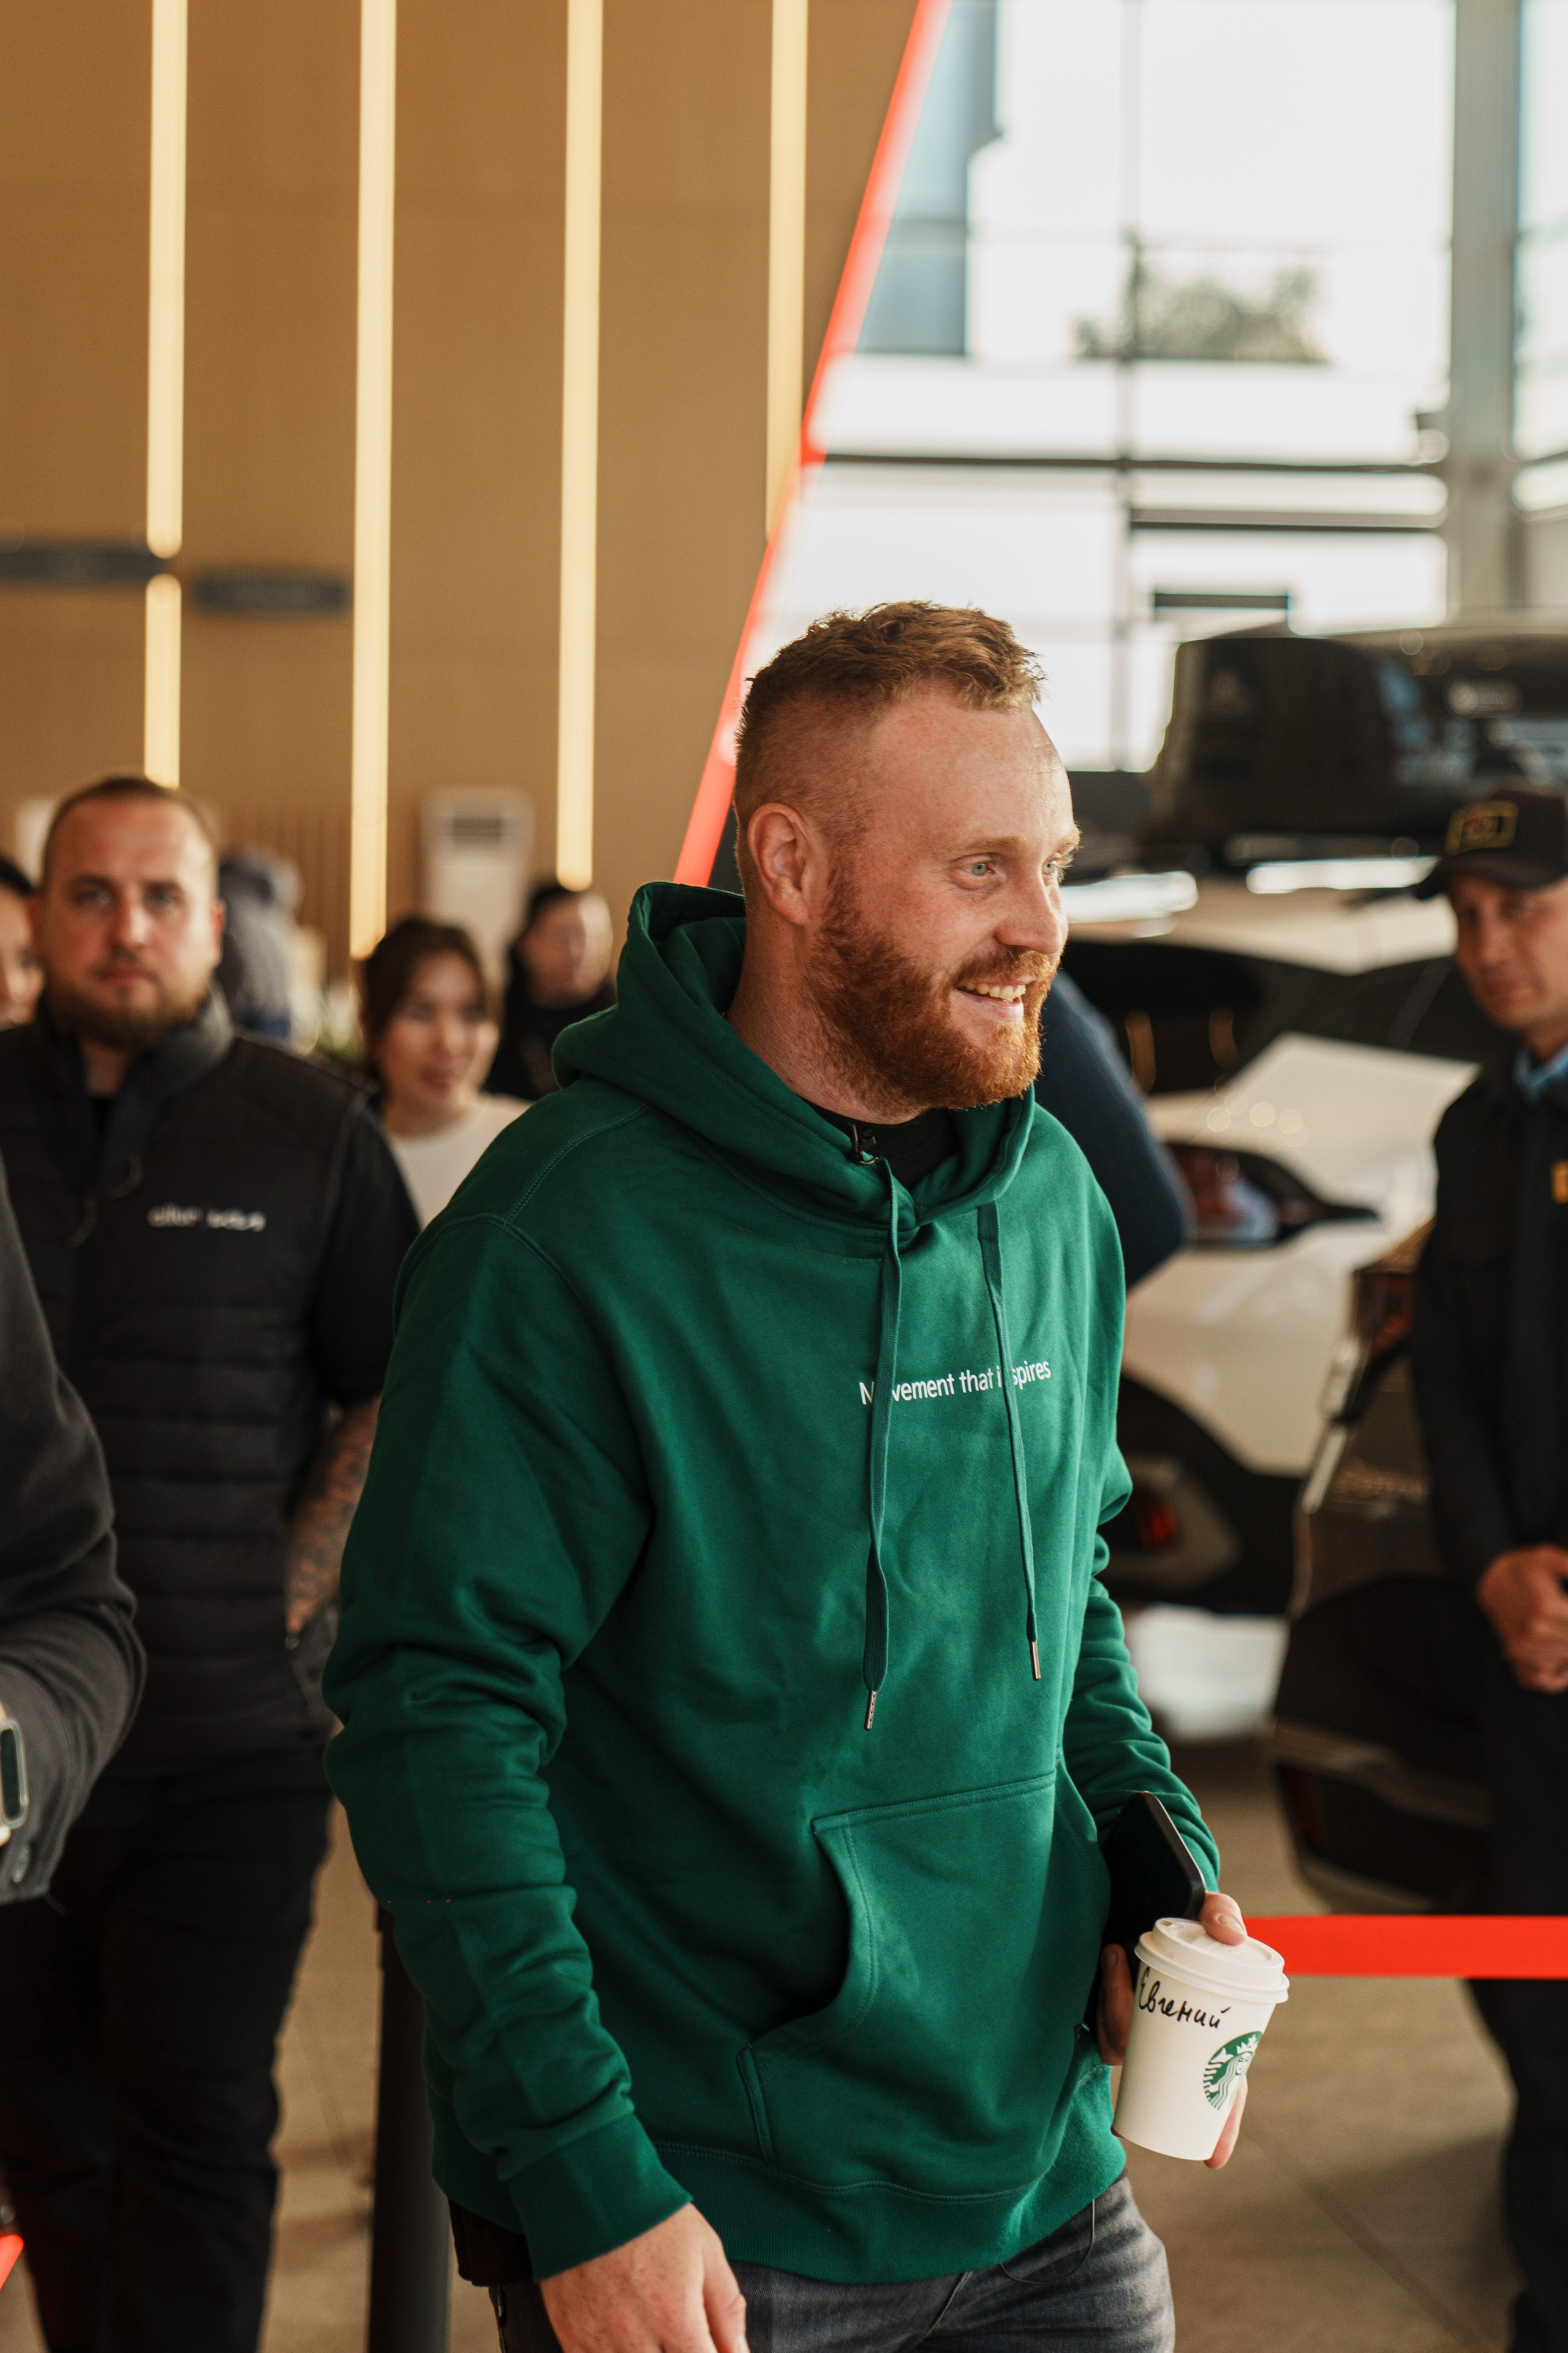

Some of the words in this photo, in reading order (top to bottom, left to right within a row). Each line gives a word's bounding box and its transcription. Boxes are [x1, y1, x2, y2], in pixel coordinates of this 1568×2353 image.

[859, 1373, 955, 1405] Mvement
[959, 1369, 993, 1394] that
[996, 1360, 1052, 1391] ispires
[1139, 1966, 1231, 2029] Евгений
